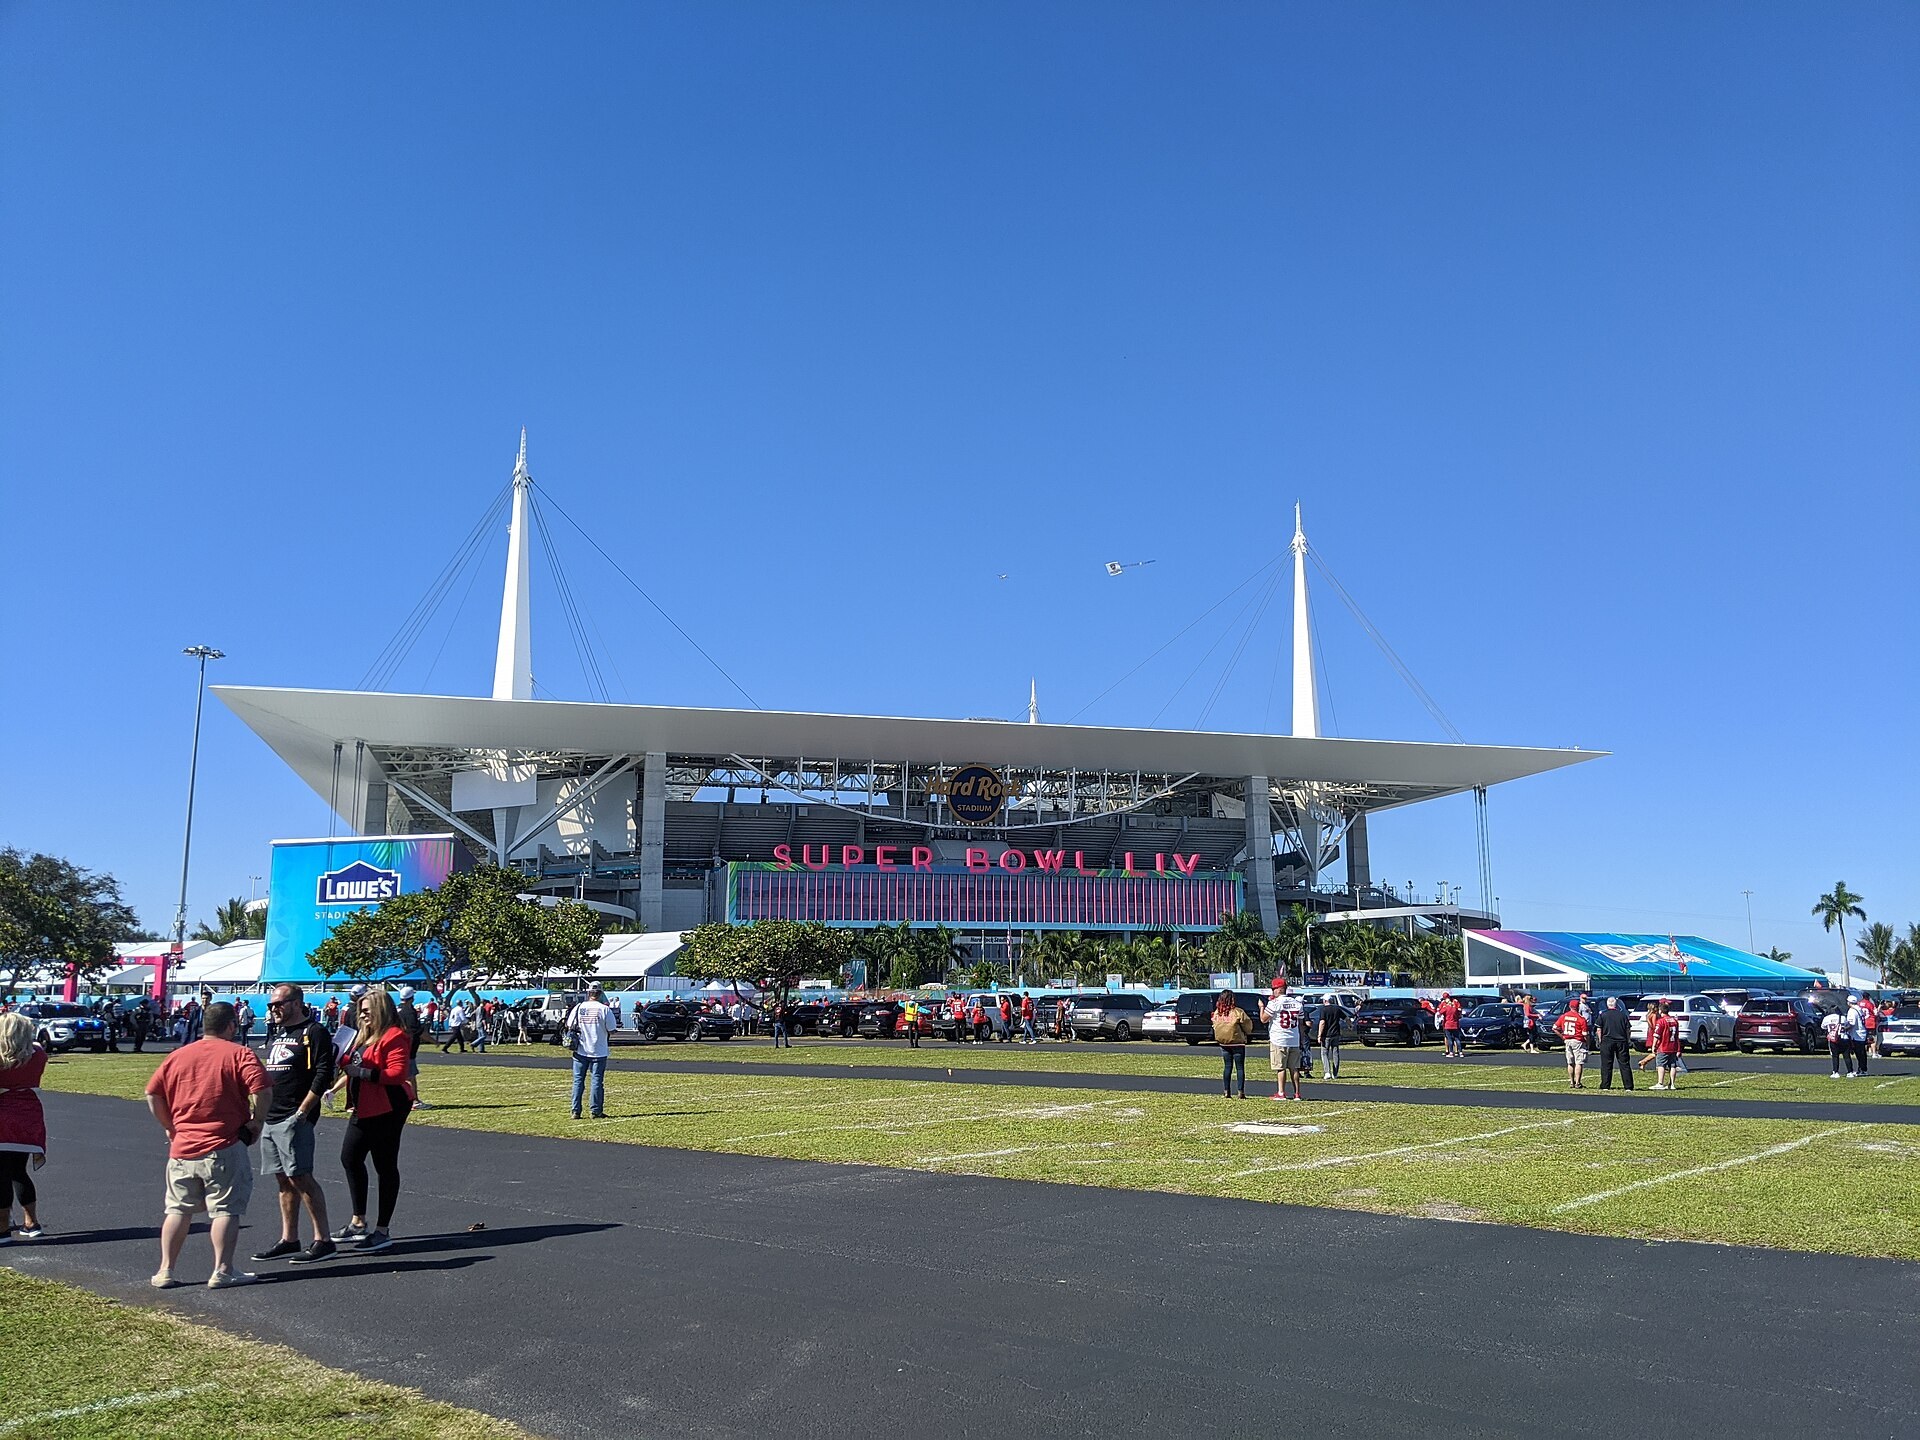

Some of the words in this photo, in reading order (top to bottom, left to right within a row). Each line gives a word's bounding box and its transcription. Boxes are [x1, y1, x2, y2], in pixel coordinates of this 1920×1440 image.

[925, 775, 975, 796] Hard
[977, 776, 1022, 801] Rock
[773, 844, 933, 873] SUPER
[966, 848, 1098, 877] BOWL
[1125, 852, 1200, 877] LIV
[326, 877, 394, 900] LOWE'S
[954, 1004, 961, 1012] 15
[1280, 1010, 1299, 1029] 85
[1563, 1022, 1576, 1036] 15
